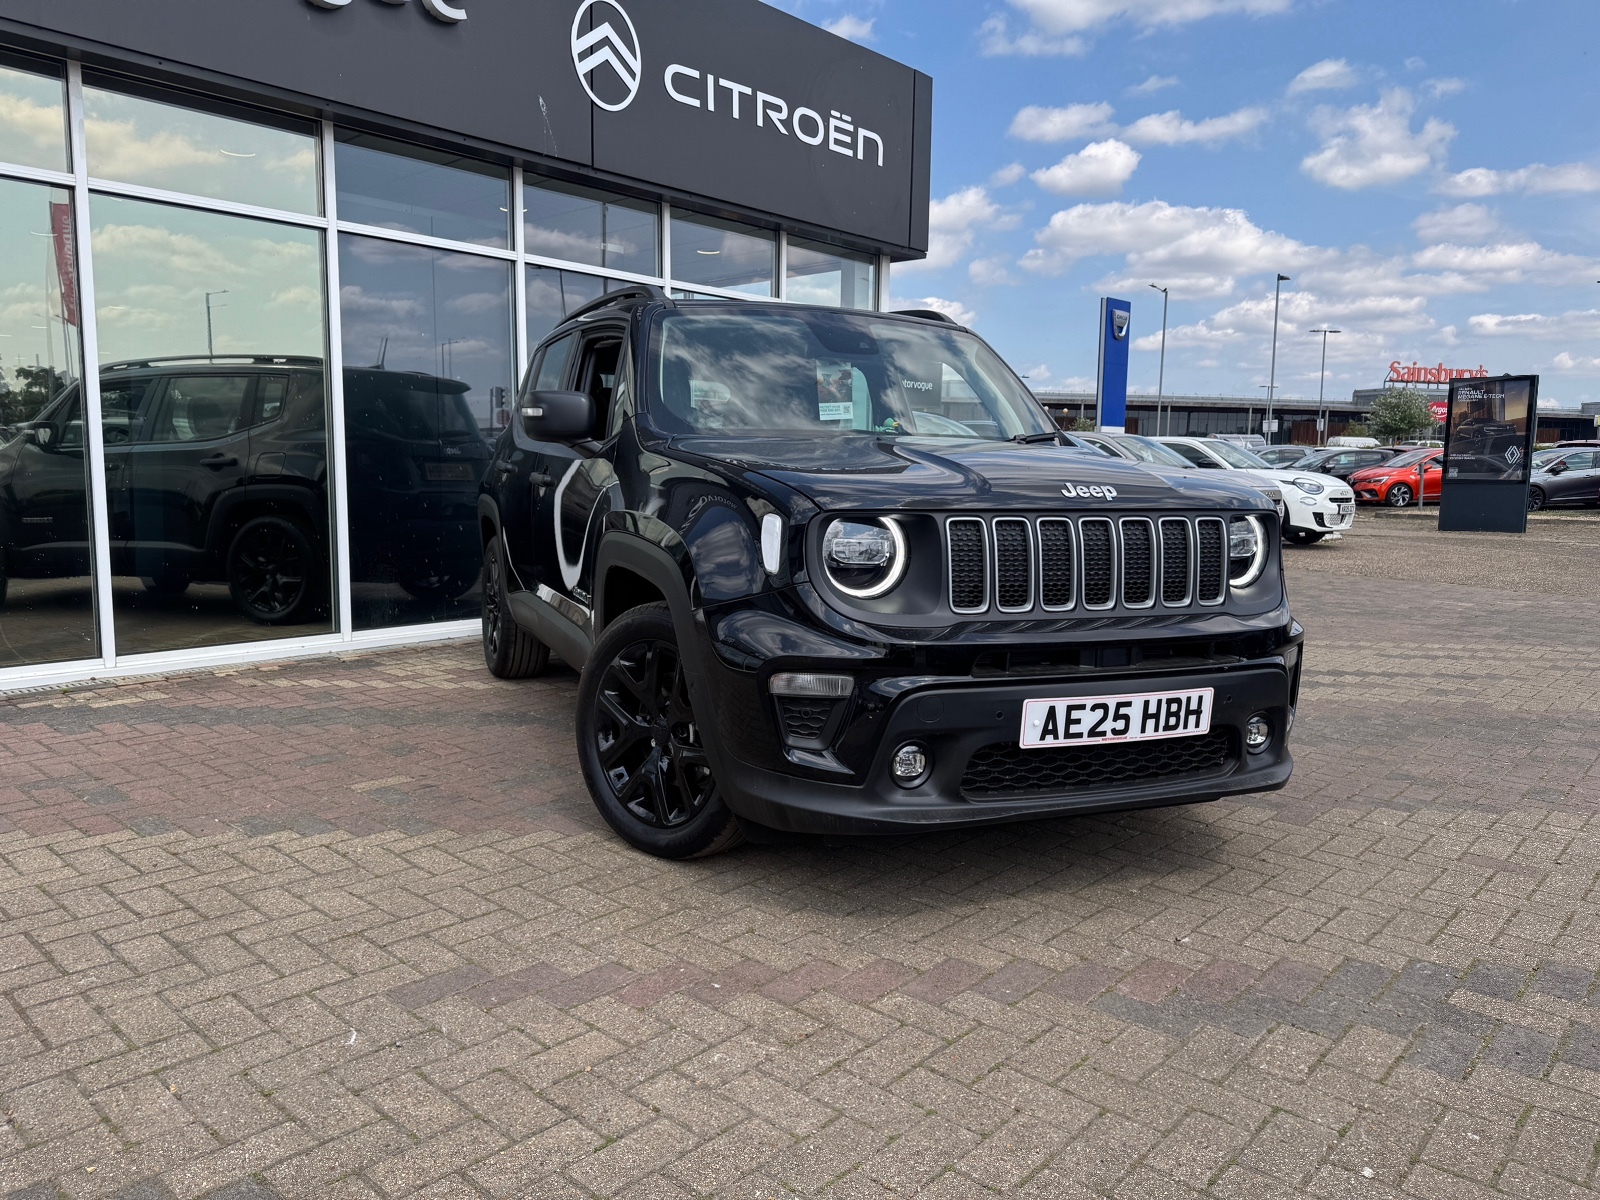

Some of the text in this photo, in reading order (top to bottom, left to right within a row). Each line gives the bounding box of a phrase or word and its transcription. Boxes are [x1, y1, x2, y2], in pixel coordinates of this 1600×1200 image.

[1389, 361, 1488, 383] Sainsbury's
[1061, 482, 1118, 500] Jeep
[1039, 695, 1204, 742] AE25 HBH
